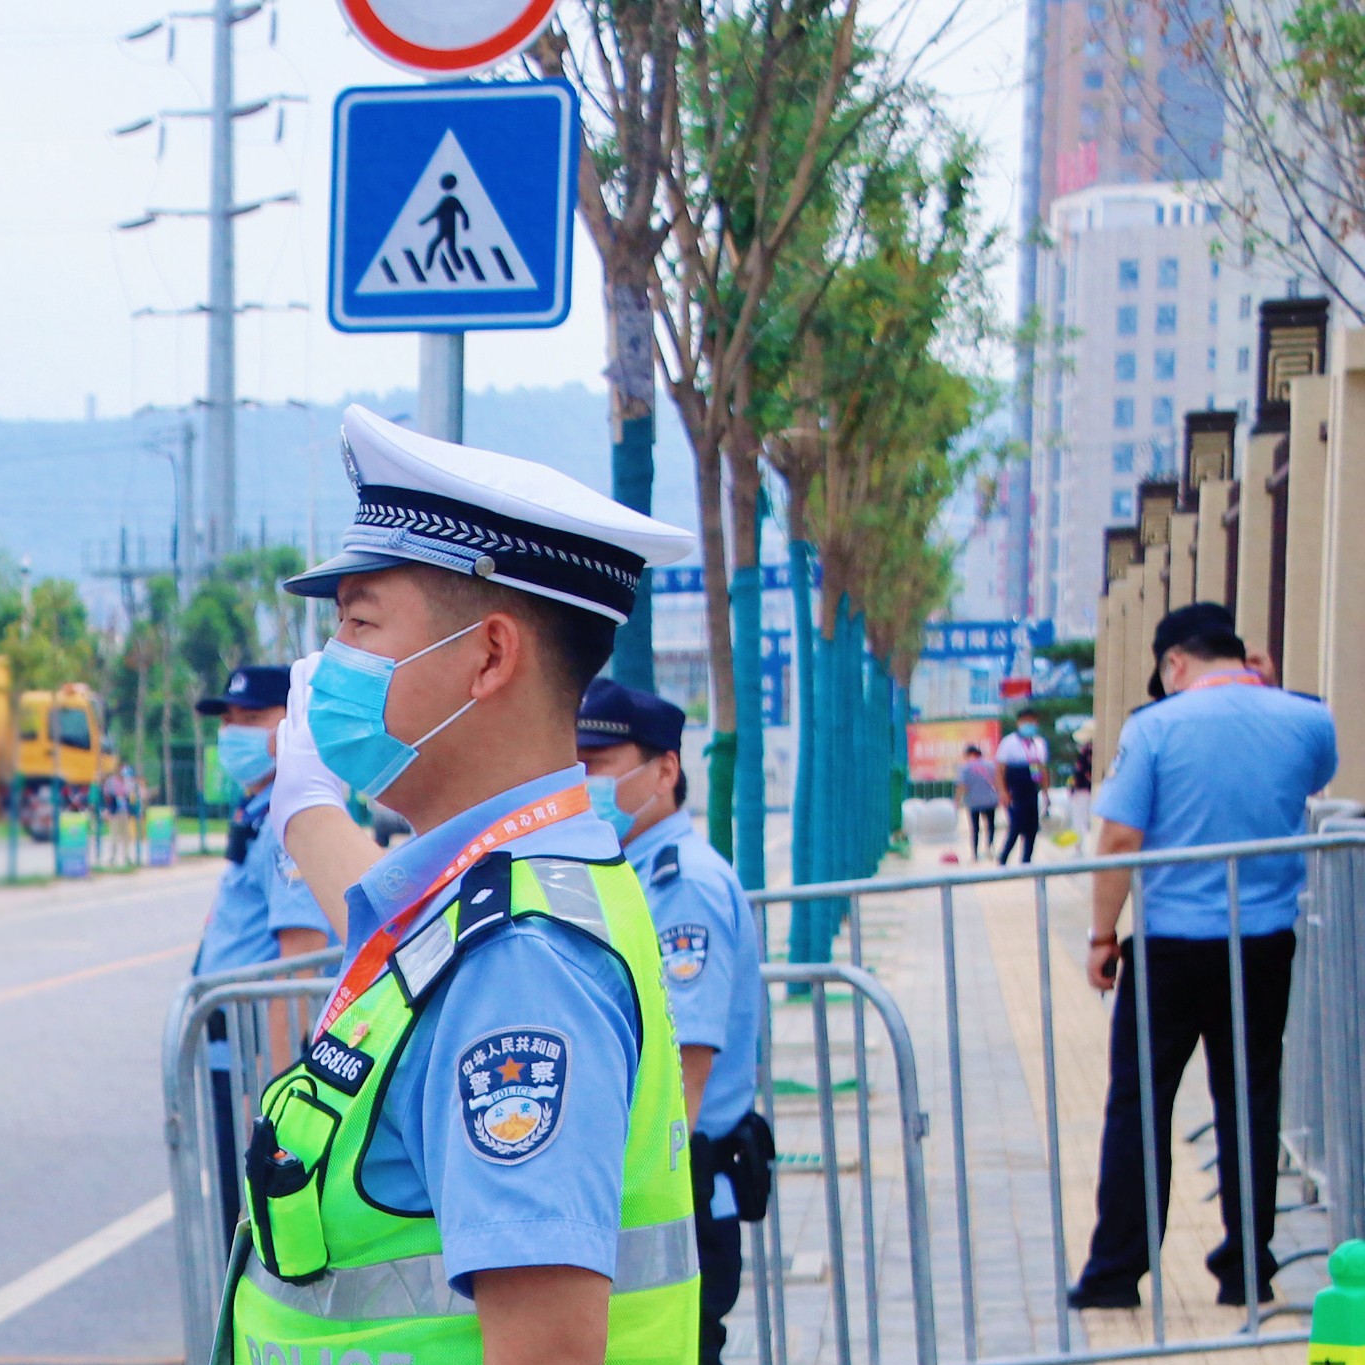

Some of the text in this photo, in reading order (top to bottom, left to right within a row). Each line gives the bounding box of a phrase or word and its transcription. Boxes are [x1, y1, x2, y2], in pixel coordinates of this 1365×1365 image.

[503, 802, 559, 834] 同心同行
[311, 1041, 363, 1081] 068146
[461, 1036, 561, 1077] 中华人民共和国
[491, 1086, 533, 1102] POLICE
